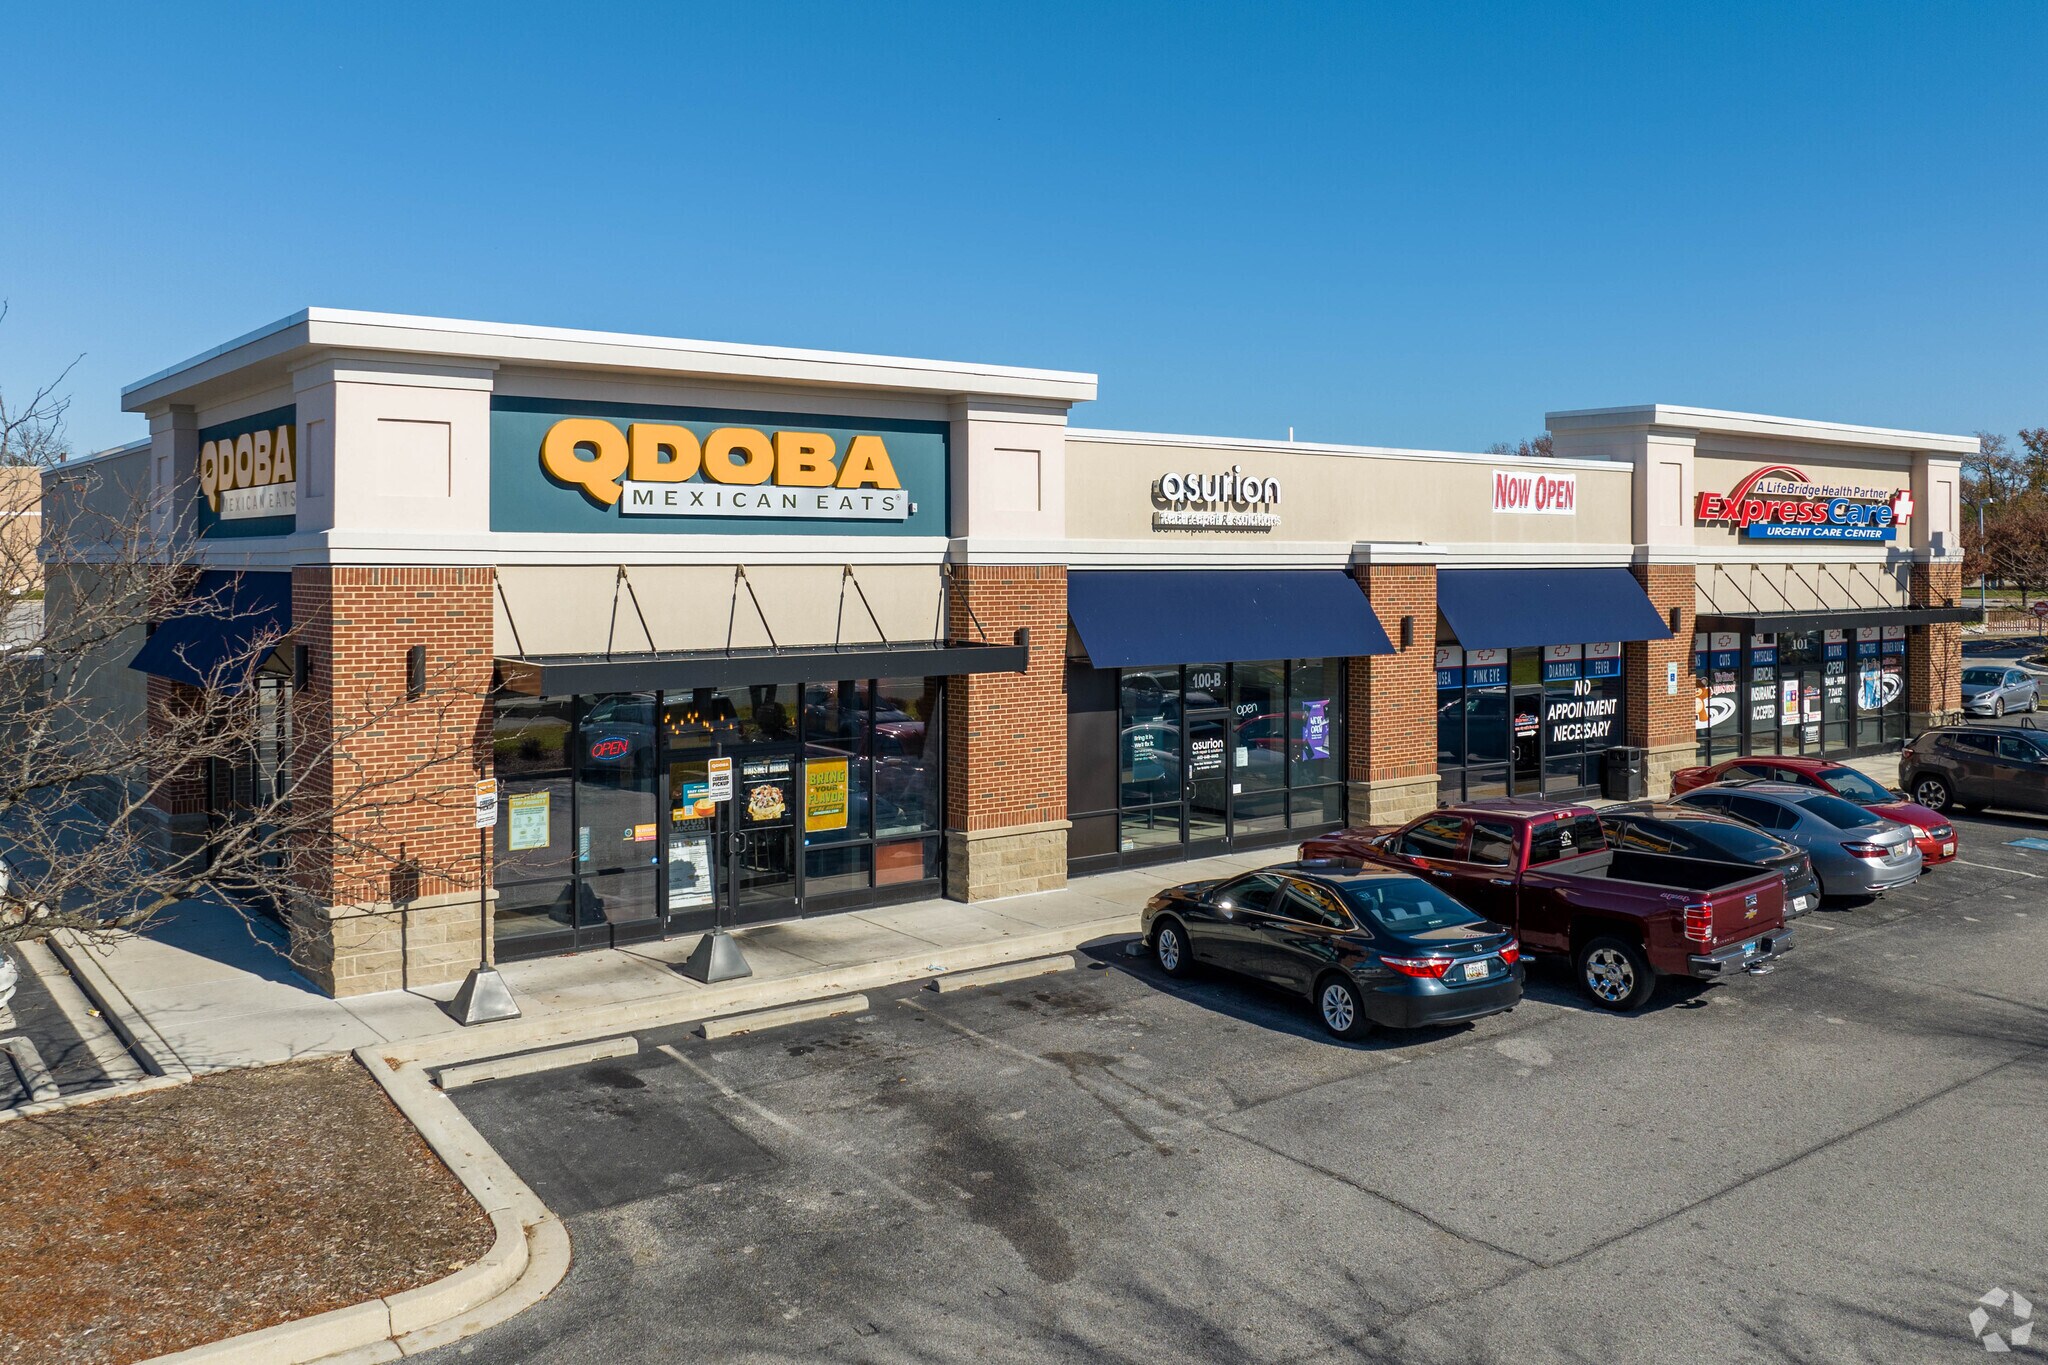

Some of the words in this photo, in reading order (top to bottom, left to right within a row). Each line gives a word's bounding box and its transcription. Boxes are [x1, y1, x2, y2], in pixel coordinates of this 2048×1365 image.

[201, 425, 295, 512] QDOBA
[542, 418, 901, 505] QDOBA
[1159, 464, 1281, 504] asurion
[1756, 481, 1764, 493] A
[1766, 482, 1820, 496] LifeBridge
[1821, 485, 1852, 497] Health
[1854, 487, 1888, 499] Partner
[633, 489, 797, 509] MEXICAN
[1495, 473, 1531, 509] NOW
[1535, 475, 1574, 511] OPEN
[224, 493, 266, 513] MEXICAN
[269, 490, 296, 509] EATS
[1699, 492, 1893, 529] ExpressCare
[1767, 527, 1811, 537] URGENT
[1813, 528, 1842, 538] CARE
[1845, 529, 1883, 539] CENTER
[1792, 639, 1808, 650] 101
[1828, 645, 1842, 657] BURNS
[1719, 653, 1731, 666] CUTS
[1754, 650, 1773, 662] PHYSICALS
[1548, 664, 1577, 678] DIARRHEA
[1595, 661, 1610, 674] FEVER
[1753, 667, 1774, 681] MEDICAL
[1826, 661, 1844, 675] OPEN
[1192, 673, 1221, 688] 100-B
[1437, 671, 1451, 685] USEA
[1473, 669, 1488, 684] PINK
[1489, 668, 1500, 682] EYE
[1574, 680, 1591, 697] NO
[1832, 687, 1843, 696] DAYS
[1236, 702, 1258, 716] open
[1752, 704, 1776, 721] ACCEPTED
[1553, 721, 1611, 742] NECESSARY
[592, 740, 628, 757] OPEN
[1192, 738, 1224, 750] asurion
[810, 770, 845, 785] BRING
[815, 784, 838, 792] YOUR
[808, 791, 844, 805] FLAVOR
